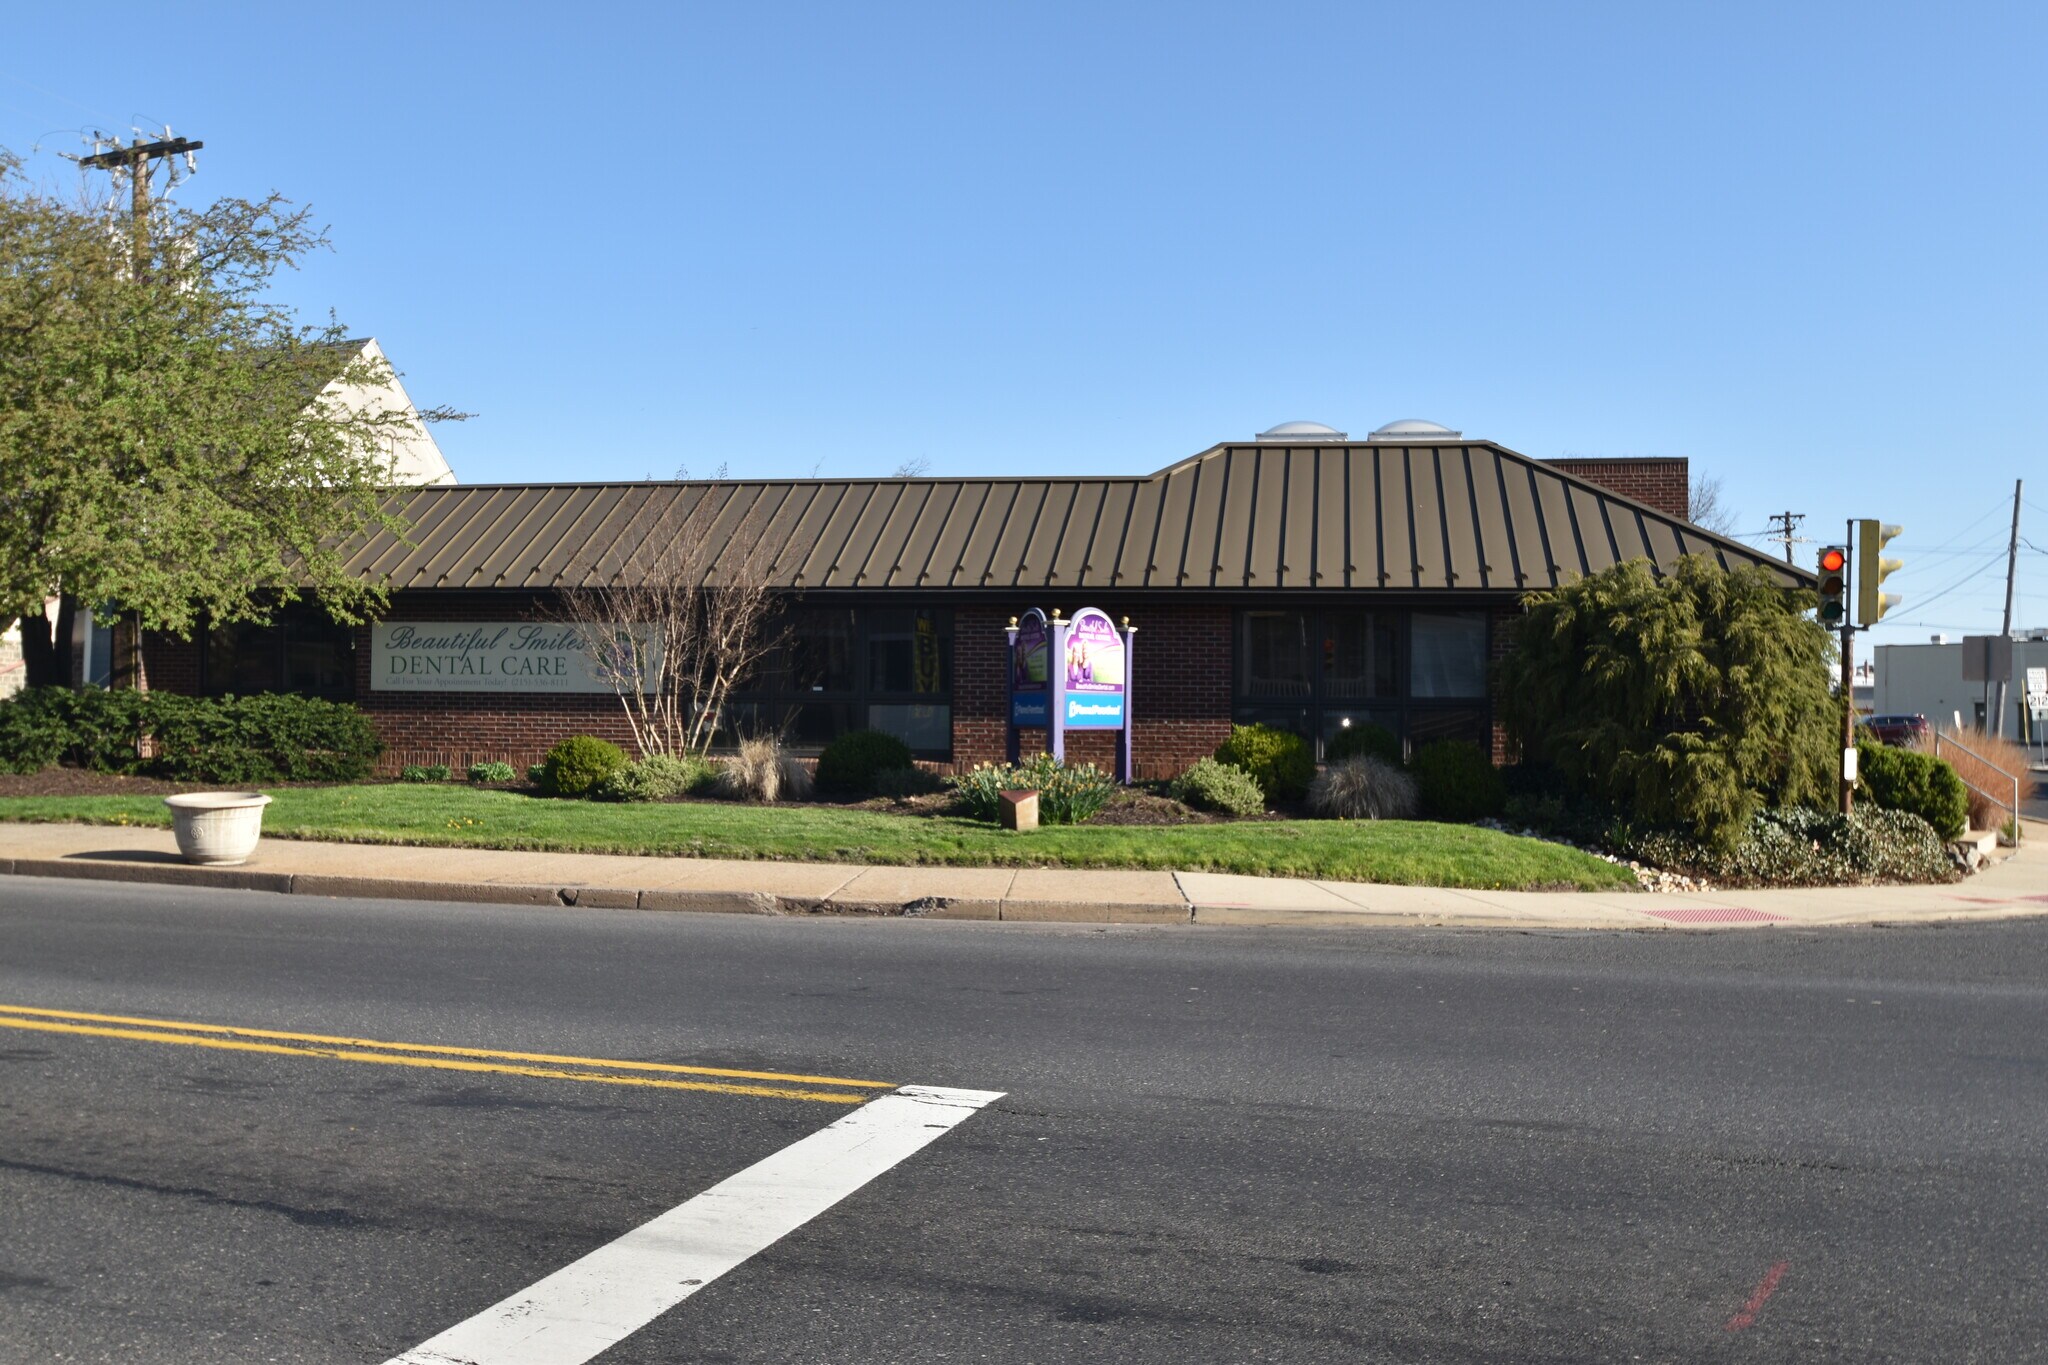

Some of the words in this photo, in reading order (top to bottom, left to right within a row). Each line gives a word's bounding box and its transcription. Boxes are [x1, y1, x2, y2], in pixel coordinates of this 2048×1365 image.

[385, 626, 509, 661] Beautiful
[510, 625, 586, 651] Smiles
[390, 656, 493, 675] DENTAL
[501, 656, 568, 675] CARE
[386, 677, 400, 685] Call
[402, 677, 414, 685] For
[434, 678, 481, 687] Appointment
[484, 678, 507, 687] Today!
[2030, 696, 2048, 706] 212
